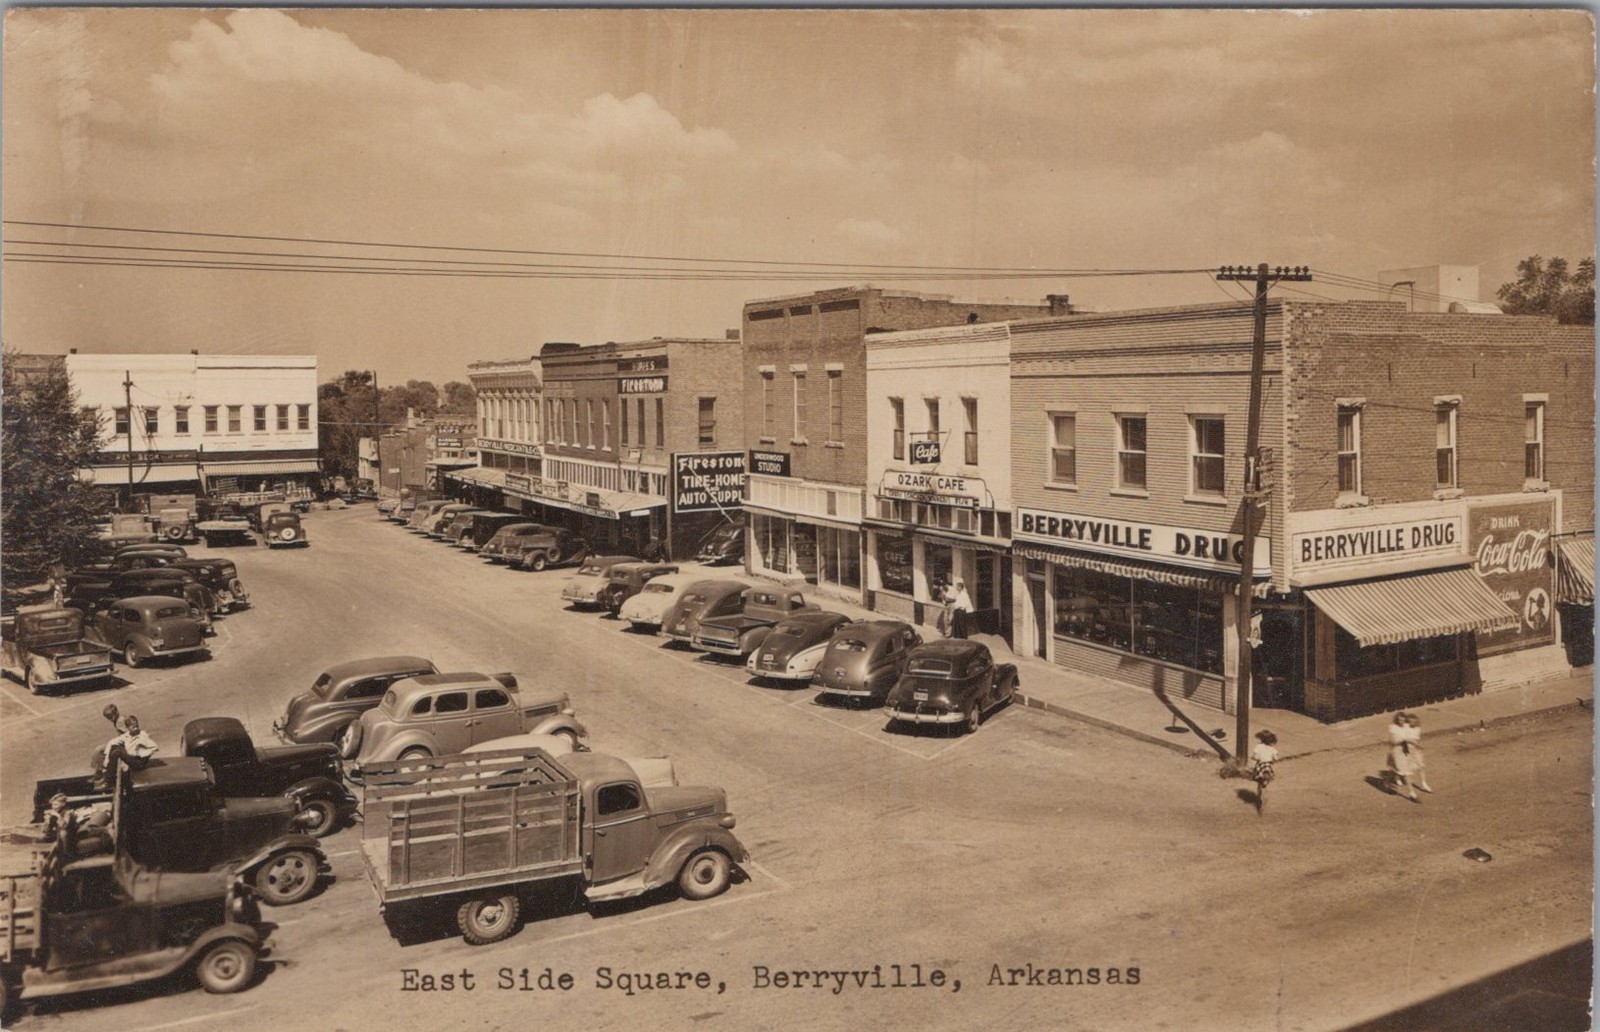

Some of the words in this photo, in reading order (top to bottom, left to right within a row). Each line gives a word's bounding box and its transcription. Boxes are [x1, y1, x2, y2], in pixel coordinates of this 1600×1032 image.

[754, 453, 784, 462] UNDERWOOD
[916, 444, 939, 462] Cafe
[758, 461, 781, 473] STUDIO
[898, 474, 932, 488] OZARK
[679, 492, 707, 505] AUTO
[711, 489, 744, 503] SUPPL
[1490, 515, 1520, 529] DRINK
[1022, 513, 1152, 550] BERRYVILLE
[1302, 528, 1404, 563] BERRYVILLE
[1412, 522, 1455, 547] DRUG
[1474, 528, 1551, 578] Coca-Cola
